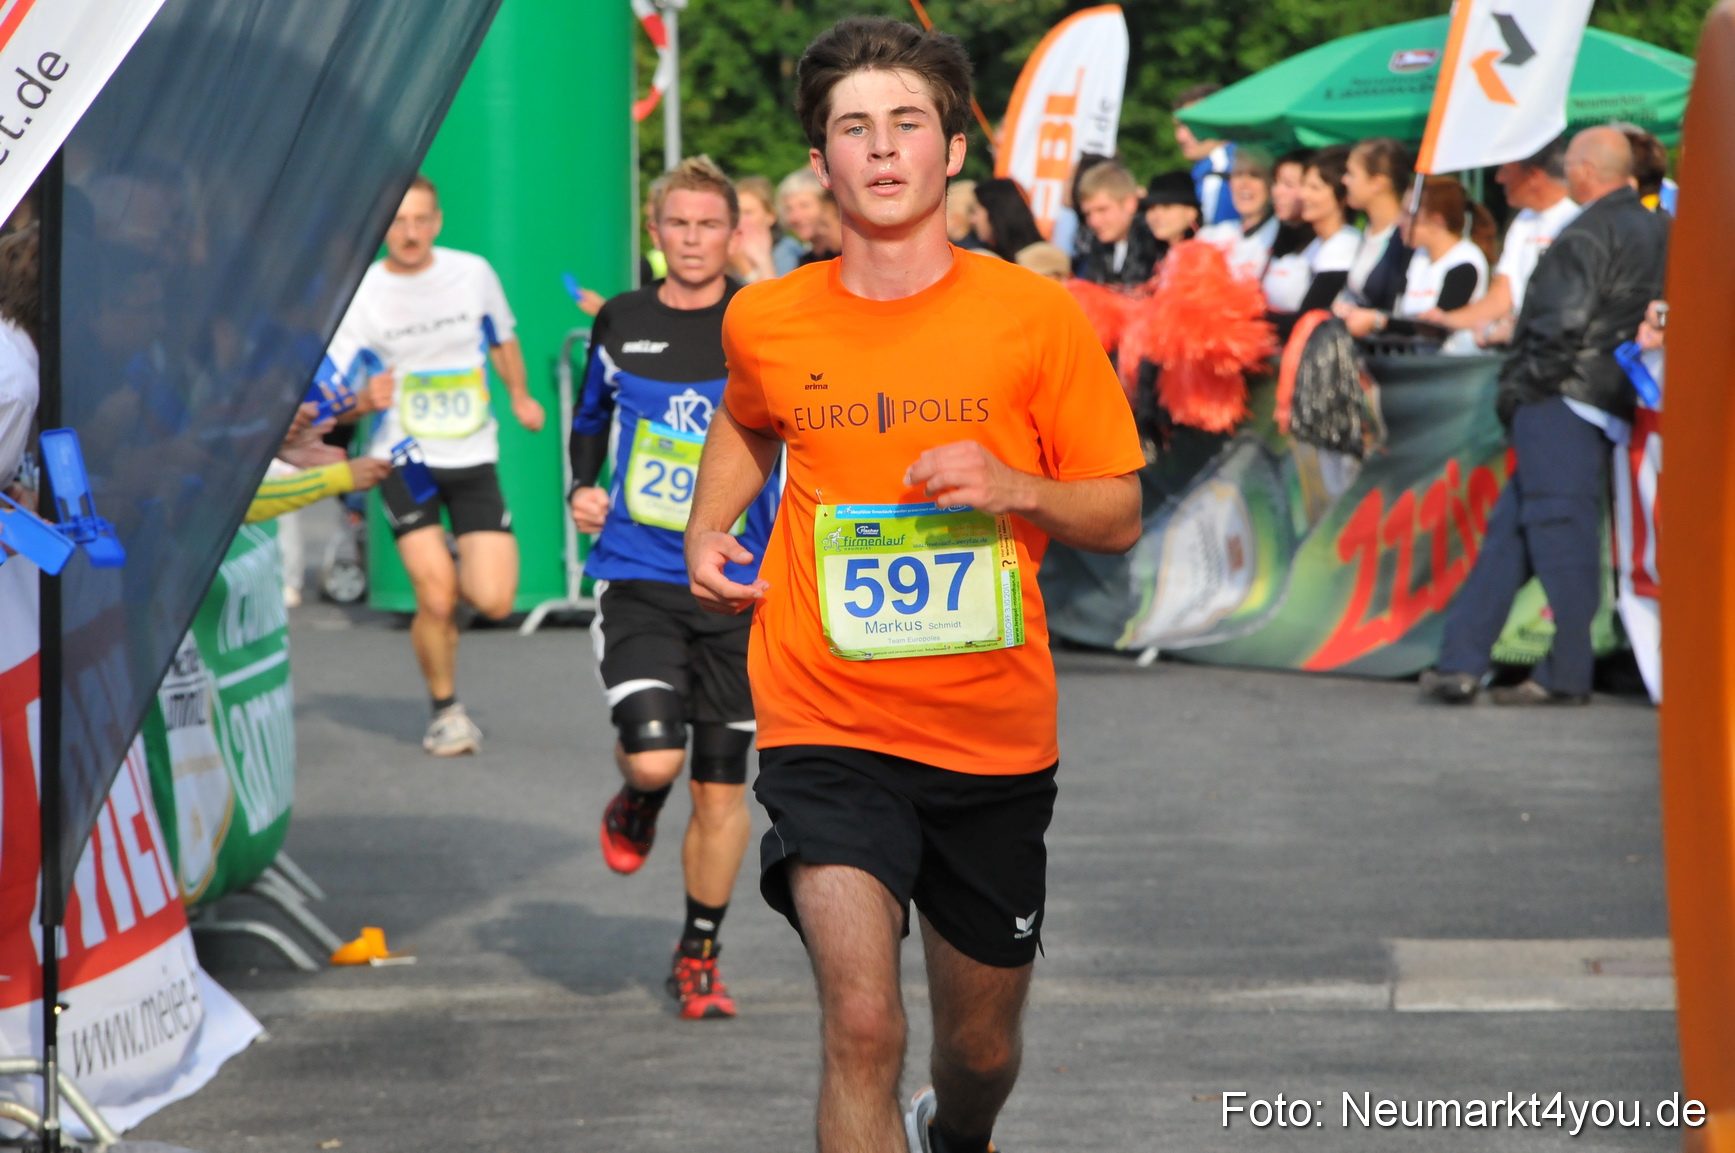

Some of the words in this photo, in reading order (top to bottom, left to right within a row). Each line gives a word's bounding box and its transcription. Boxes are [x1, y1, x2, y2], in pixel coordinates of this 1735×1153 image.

[411, 391, 471, 420] 930
[794, 403, 869, 431] EURO
[902, 398, 989, 423] POLES
[639, 460, 694, 504] 29
[843, 534, 906, 546] firmenlauf
[843, 551, 975, 619] 597
[865, 619, 923, 634] Markus
[928, 621, 962, 630] Schmidt
[907, 635, 941, 644] Europoles
[72, 946, 199, 1078] www.meier-
